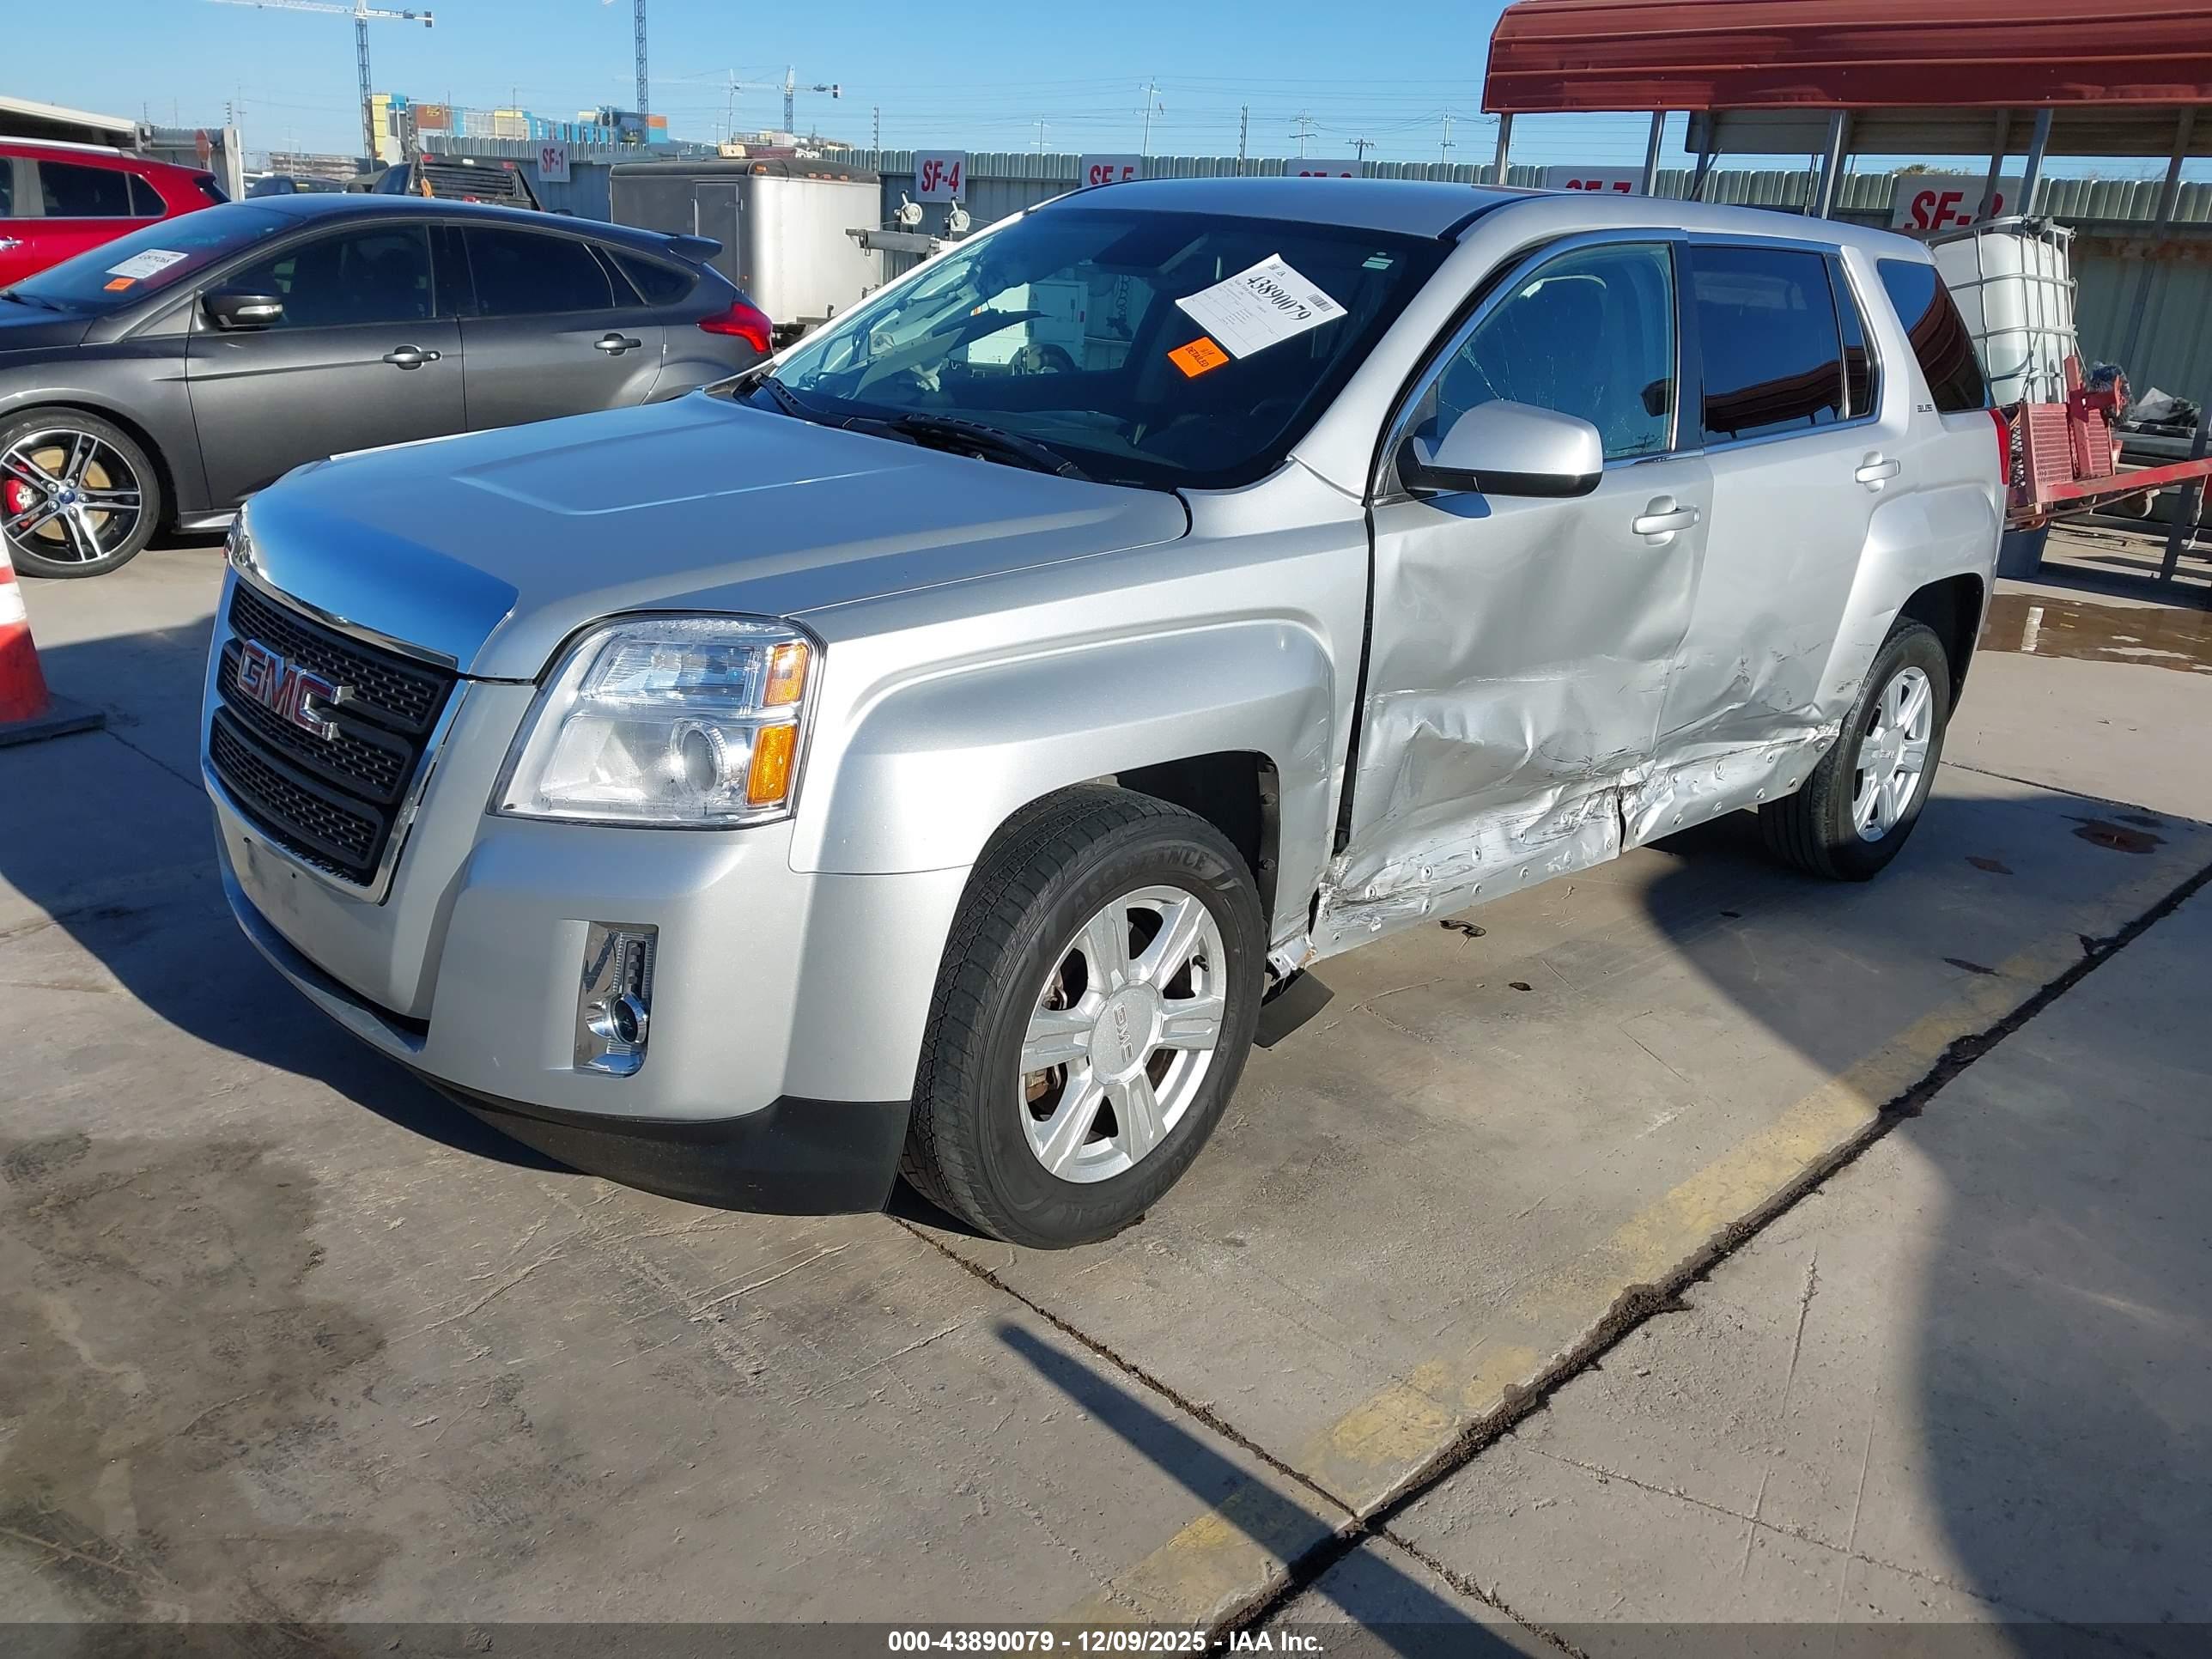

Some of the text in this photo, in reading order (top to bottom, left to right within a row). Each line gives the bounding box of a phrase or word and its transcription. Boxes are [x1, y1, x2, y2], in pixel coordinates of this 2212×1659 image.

[542, 148, 563, 173] SF-1
[921, 160, 960, 192] SF-4
[1247, 276, 1311, 320] 43890079
[237, 639, 349, 741] GMC
[1114, 1003, 1133, 1063] GMC
